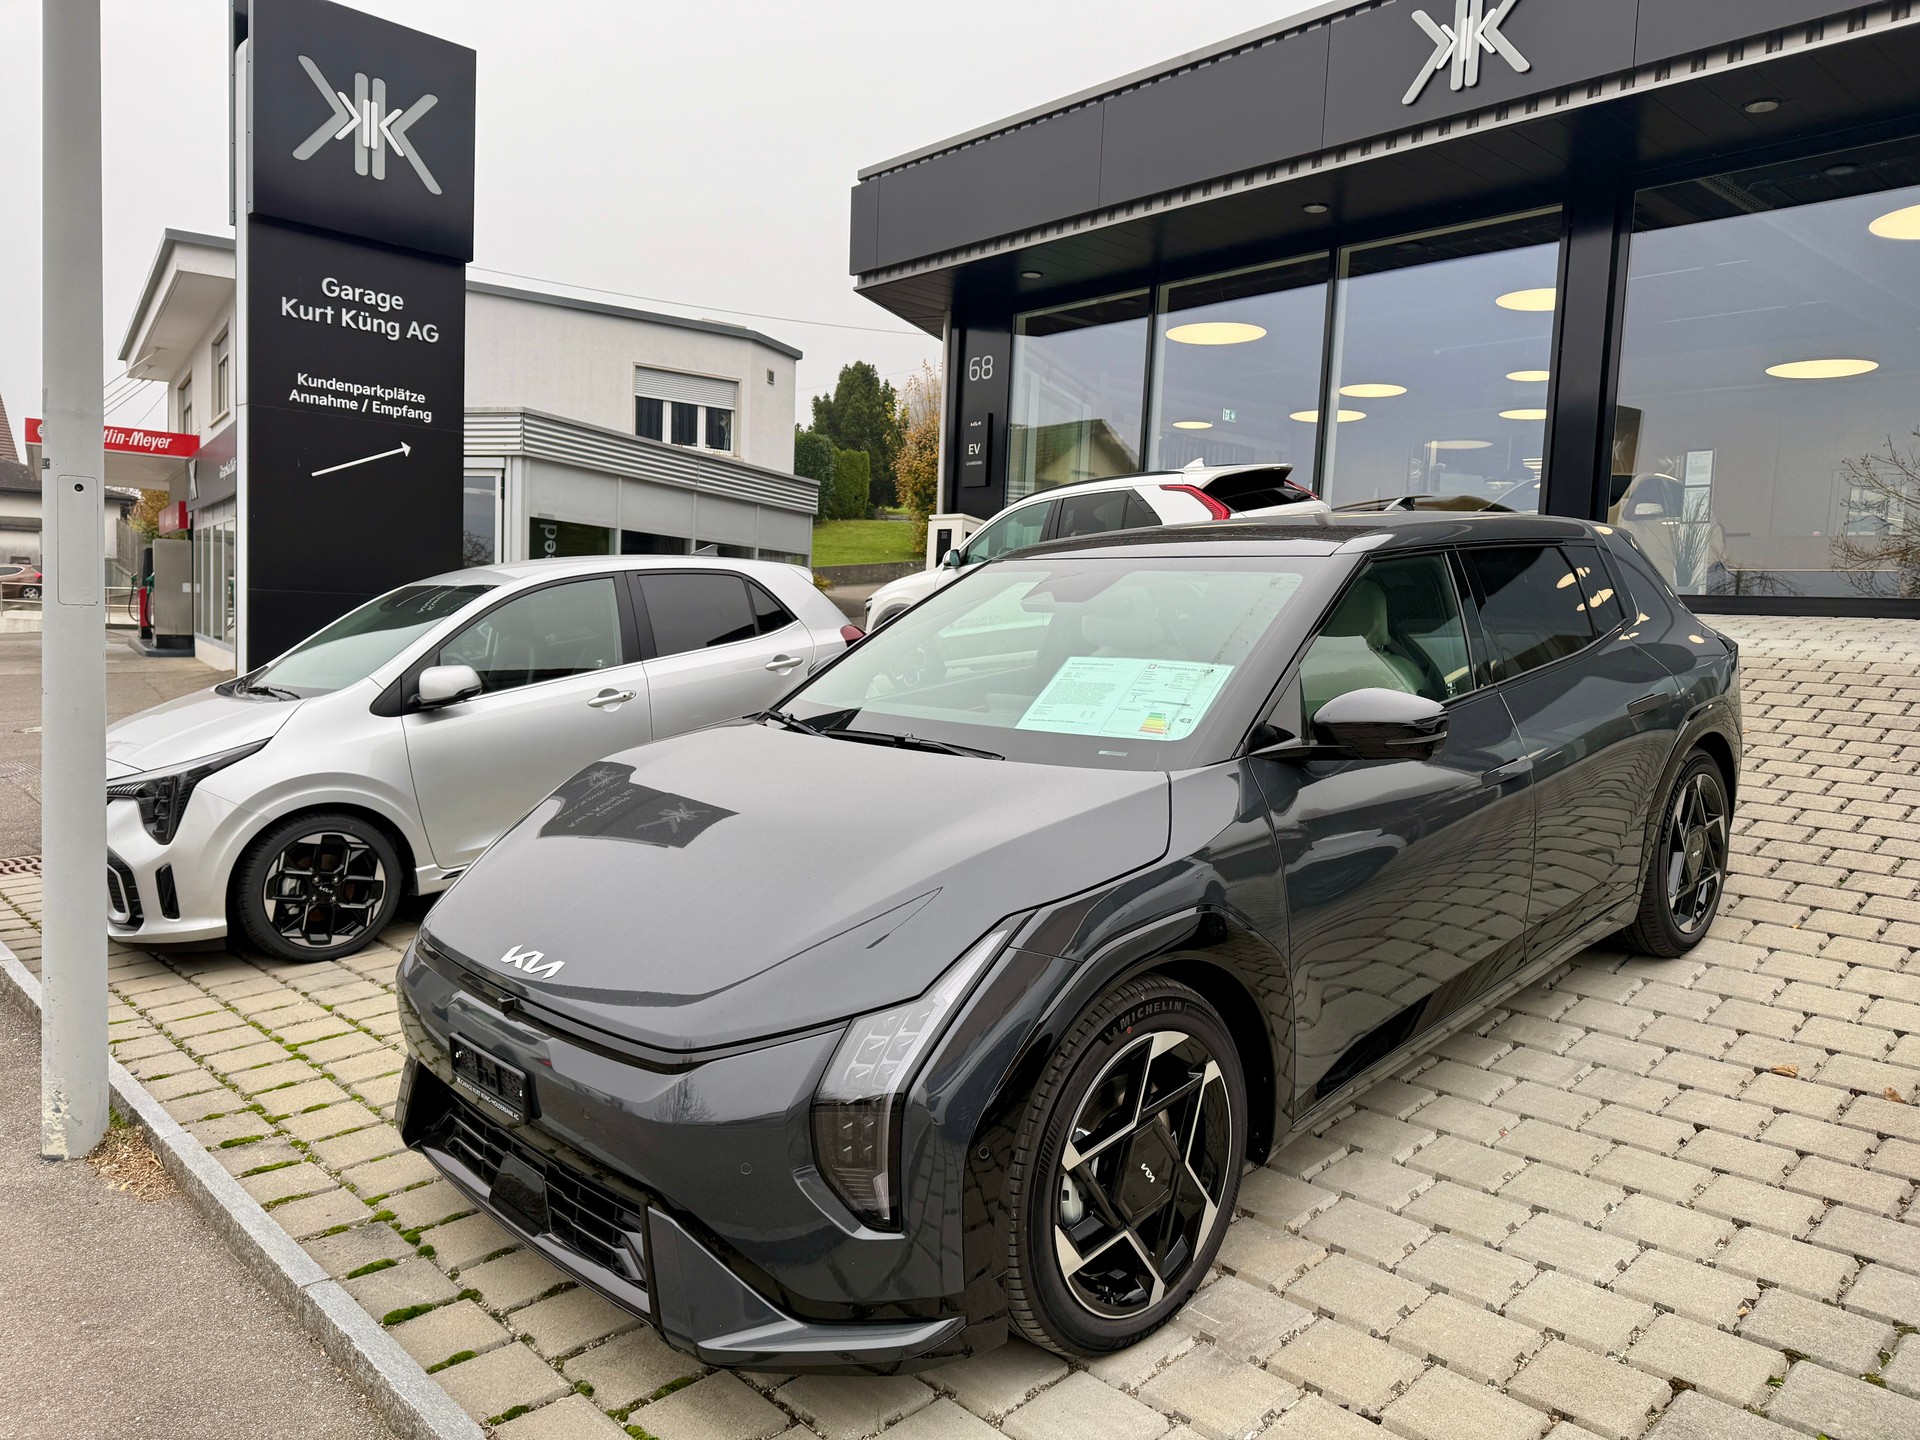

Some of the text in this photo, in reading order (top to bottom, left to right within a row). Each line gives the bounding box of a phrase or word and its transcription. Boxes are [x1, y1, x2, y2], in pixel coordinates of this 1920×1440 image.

[321, 277, 404, 312] Garage
[281, 296, 439, 343] Kurt Küng AG
[969, 355, 993, 381] 68
[297, 372, 426, 403] Kundenparkplätze
[288, 388, 358, 410] Annahme
[372, 400, 432, 423] Empfang
[968, 443, 981, 455] EV
[1119, 1001, 1182, 1031] MICHELIN
